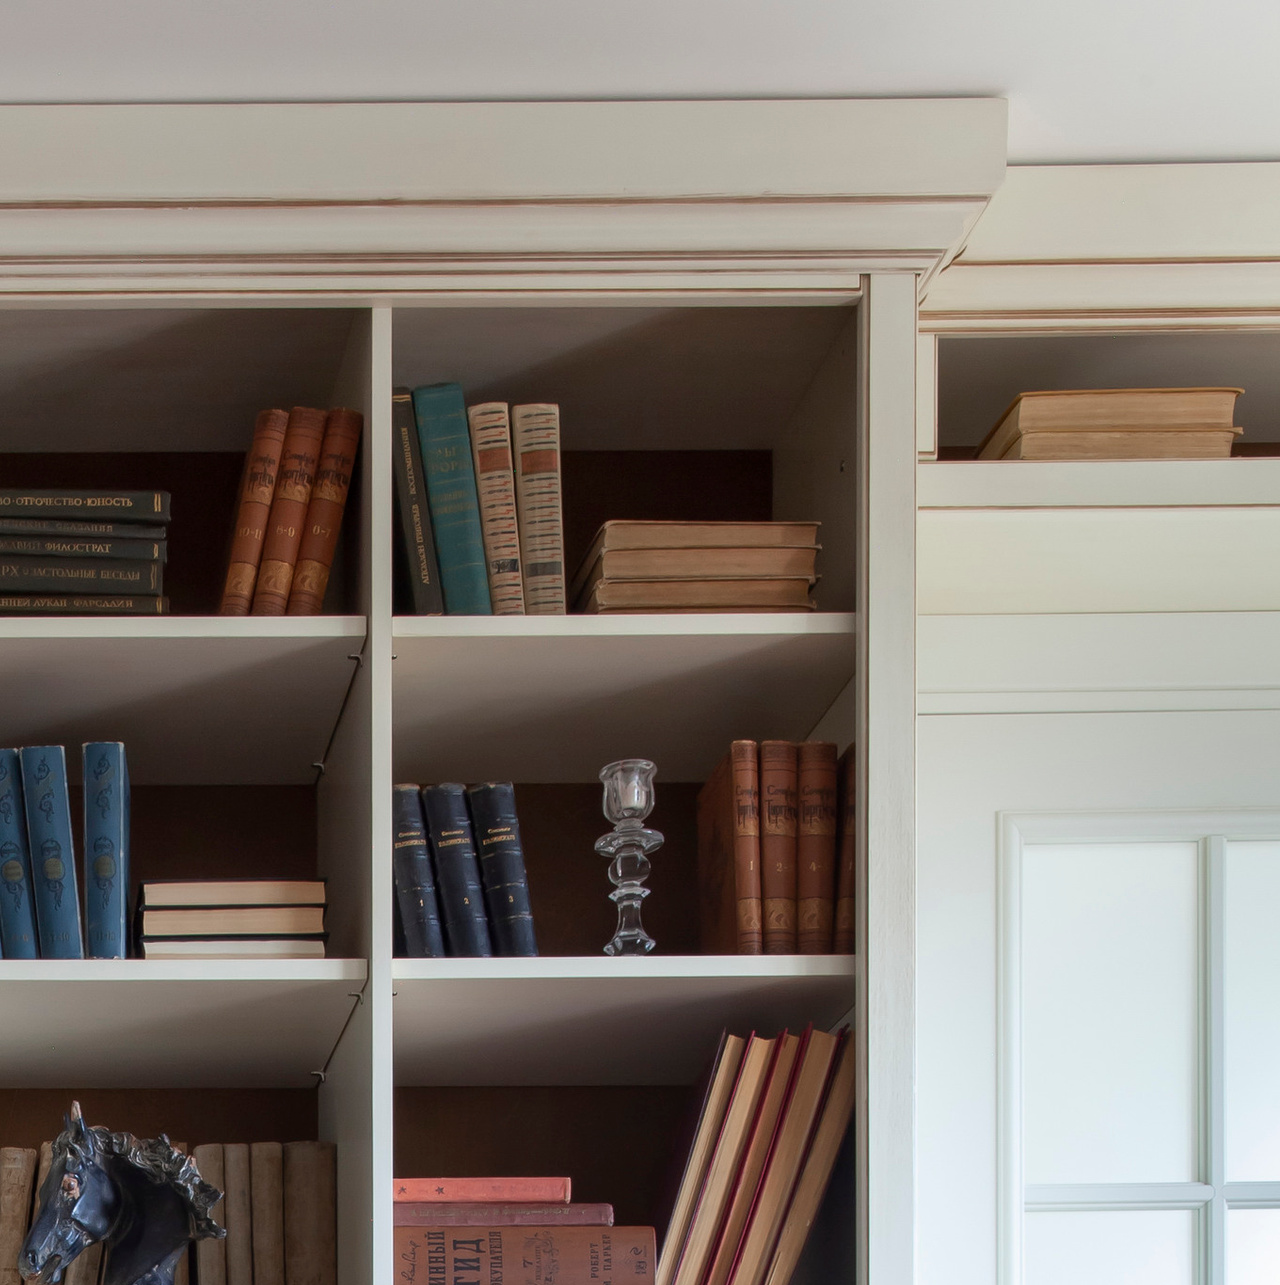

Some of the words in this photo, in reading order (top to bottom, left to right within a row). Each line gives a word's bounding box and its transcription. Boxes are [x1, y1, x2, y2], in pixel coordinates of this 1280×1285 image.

[44, 542, 112, 553] ФИЛОСТРАТ
[523, 1257, 533, 1268] 7
[590, 1242, 599, 1279] РОБЕРТ
[603, 1233, 612, 1270] ПАРКЕР
